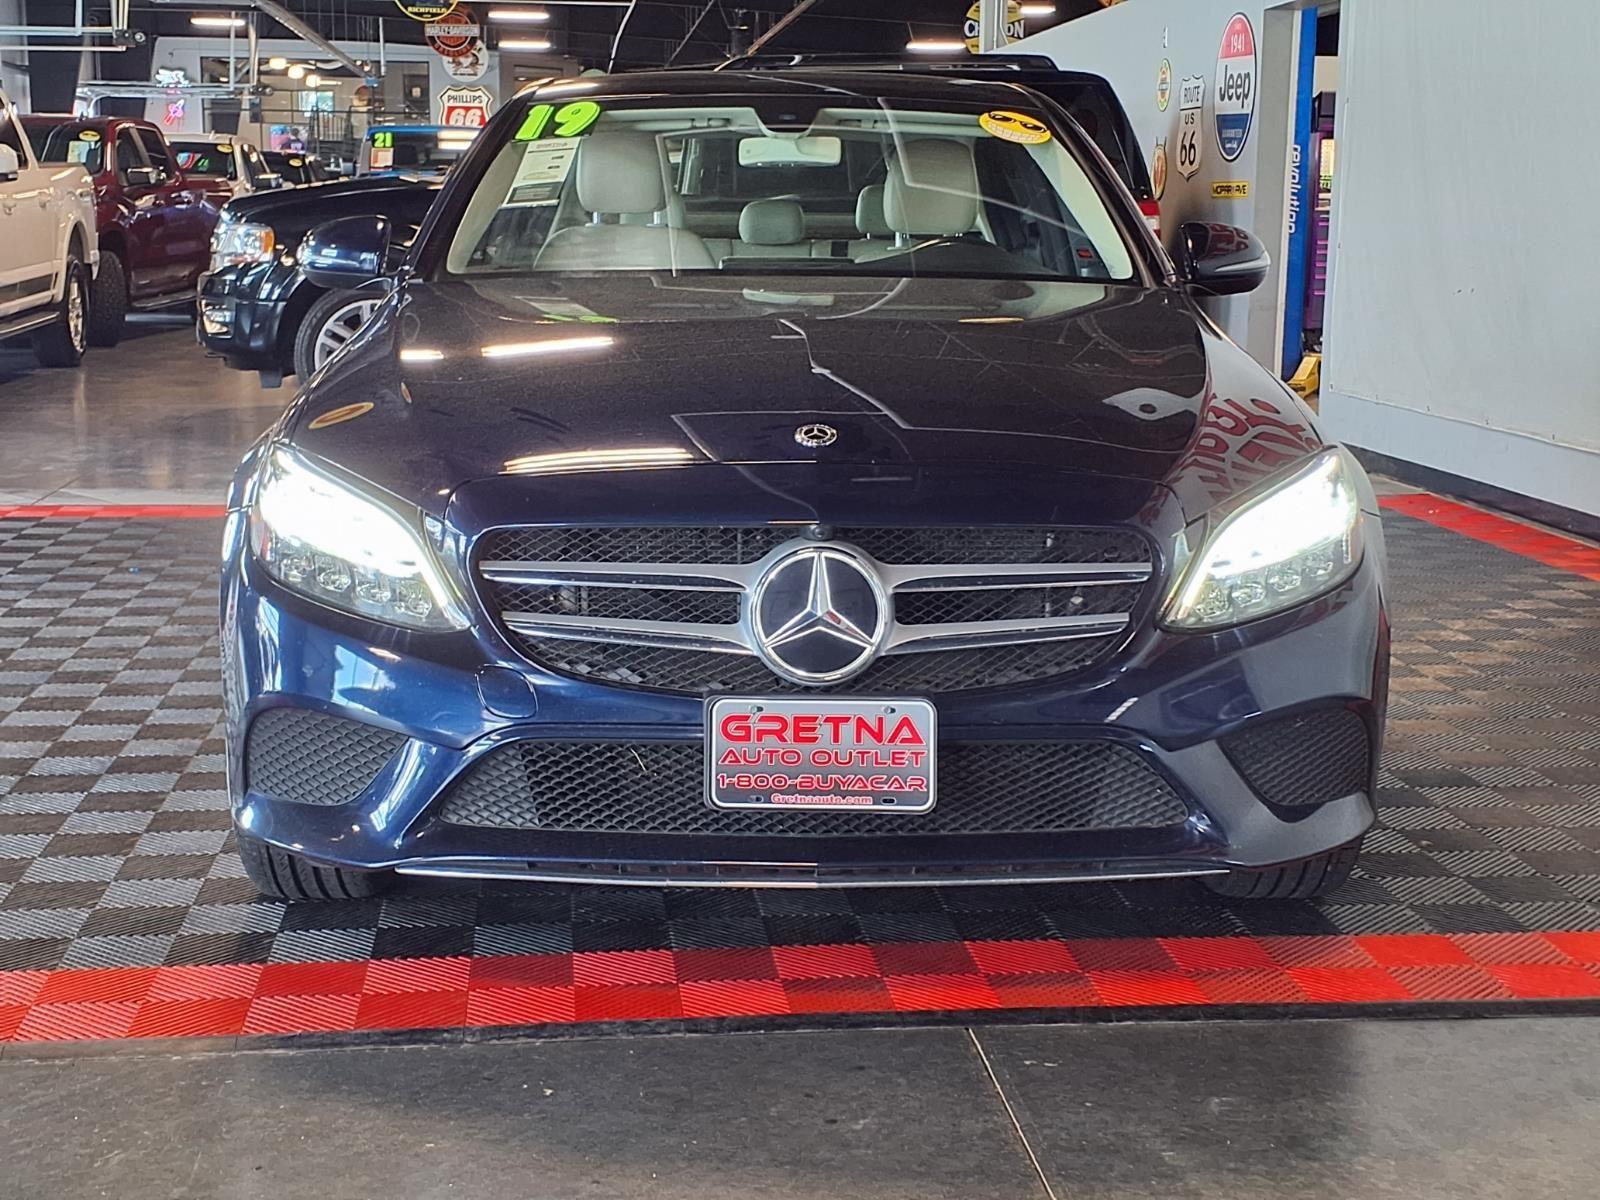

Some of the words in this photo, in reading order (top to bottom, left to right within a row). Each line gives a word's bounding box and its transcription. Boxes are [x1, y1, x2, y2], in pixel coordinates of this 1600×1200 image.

[1230, 33, 1245, 54] 1941
[1184, 85, 1201, 103] ROUTE
[1219, 64, 1250, 109] Jeep
[447, 94, 483, 104] PHILLIPS
[448, 108, 481, 127] 66
[514, 101, 600, 141] 19
[373, 132, 393, 148] 21
[1179, 131, 1197, 167] 66
[719, 713, 926, 746] GRETNA
[717, 748, 803, 767] AUTO
[809, 748, 928, 768] OUTLET
[717, 773, 928, 792] 1-800-BUYACAR
[770, 793, 874, 805] Gretnaauto.com
